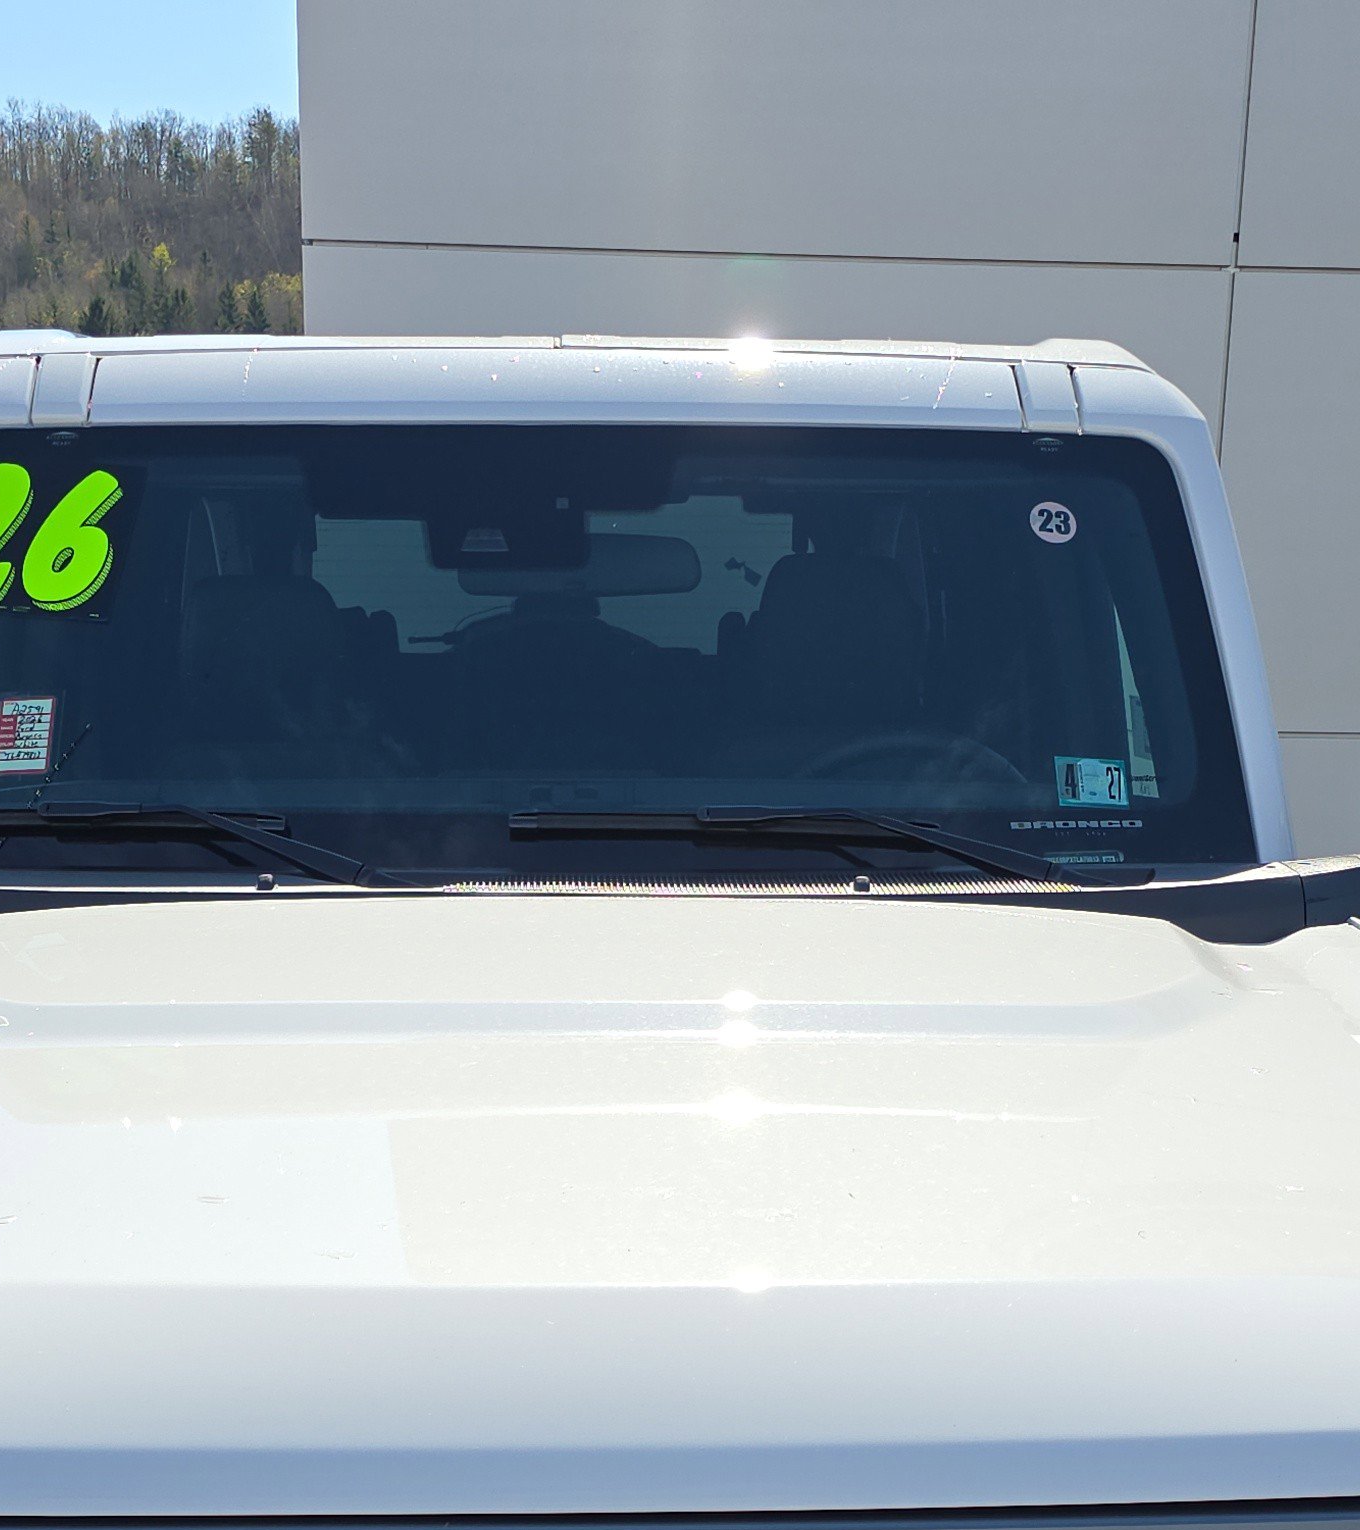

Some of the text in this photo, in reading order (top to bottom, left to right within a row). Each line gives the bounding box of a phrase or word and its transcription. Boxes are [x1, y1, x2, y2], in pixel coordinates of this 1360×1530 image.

[1037, 508, 1072, 535] 23
[1064, 764, 1077, 799] 4
[1106, 766, 1121, 802] 27
[1010, 820, 1143, 830] BRONCO
